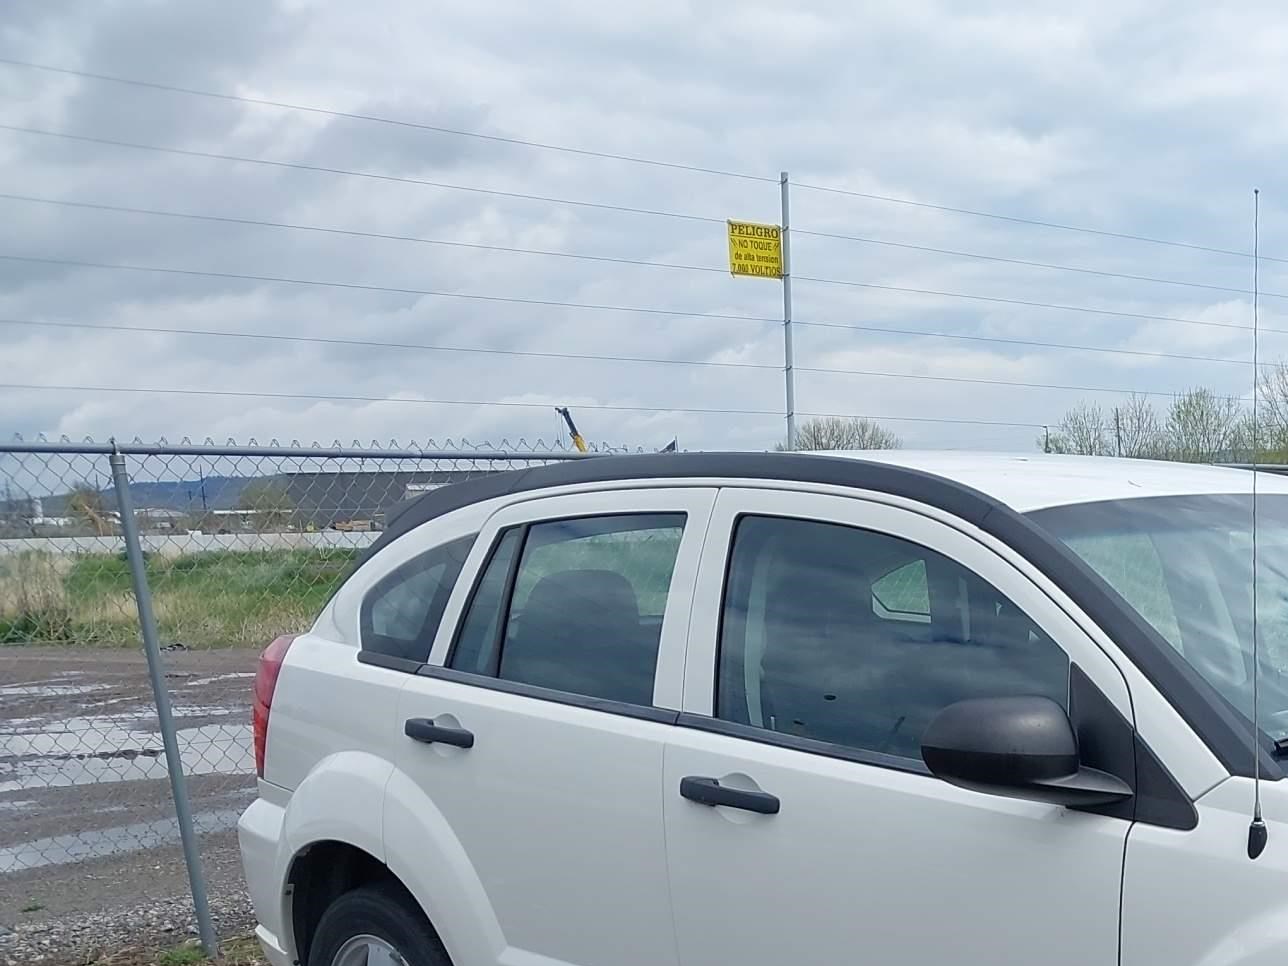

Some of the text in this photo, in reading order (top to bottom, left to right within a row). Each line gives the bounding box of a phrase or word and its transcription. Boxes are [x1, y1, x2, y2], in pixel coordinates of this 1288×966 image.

[730, 224, 778, 238] PELIGRO
[738, 239, 772, 251] NO TOQUE
[734, 251, 743, 260] de
[744, 252, 755, 261] alta
[750, 264, 781, 276] VOLTIOS
